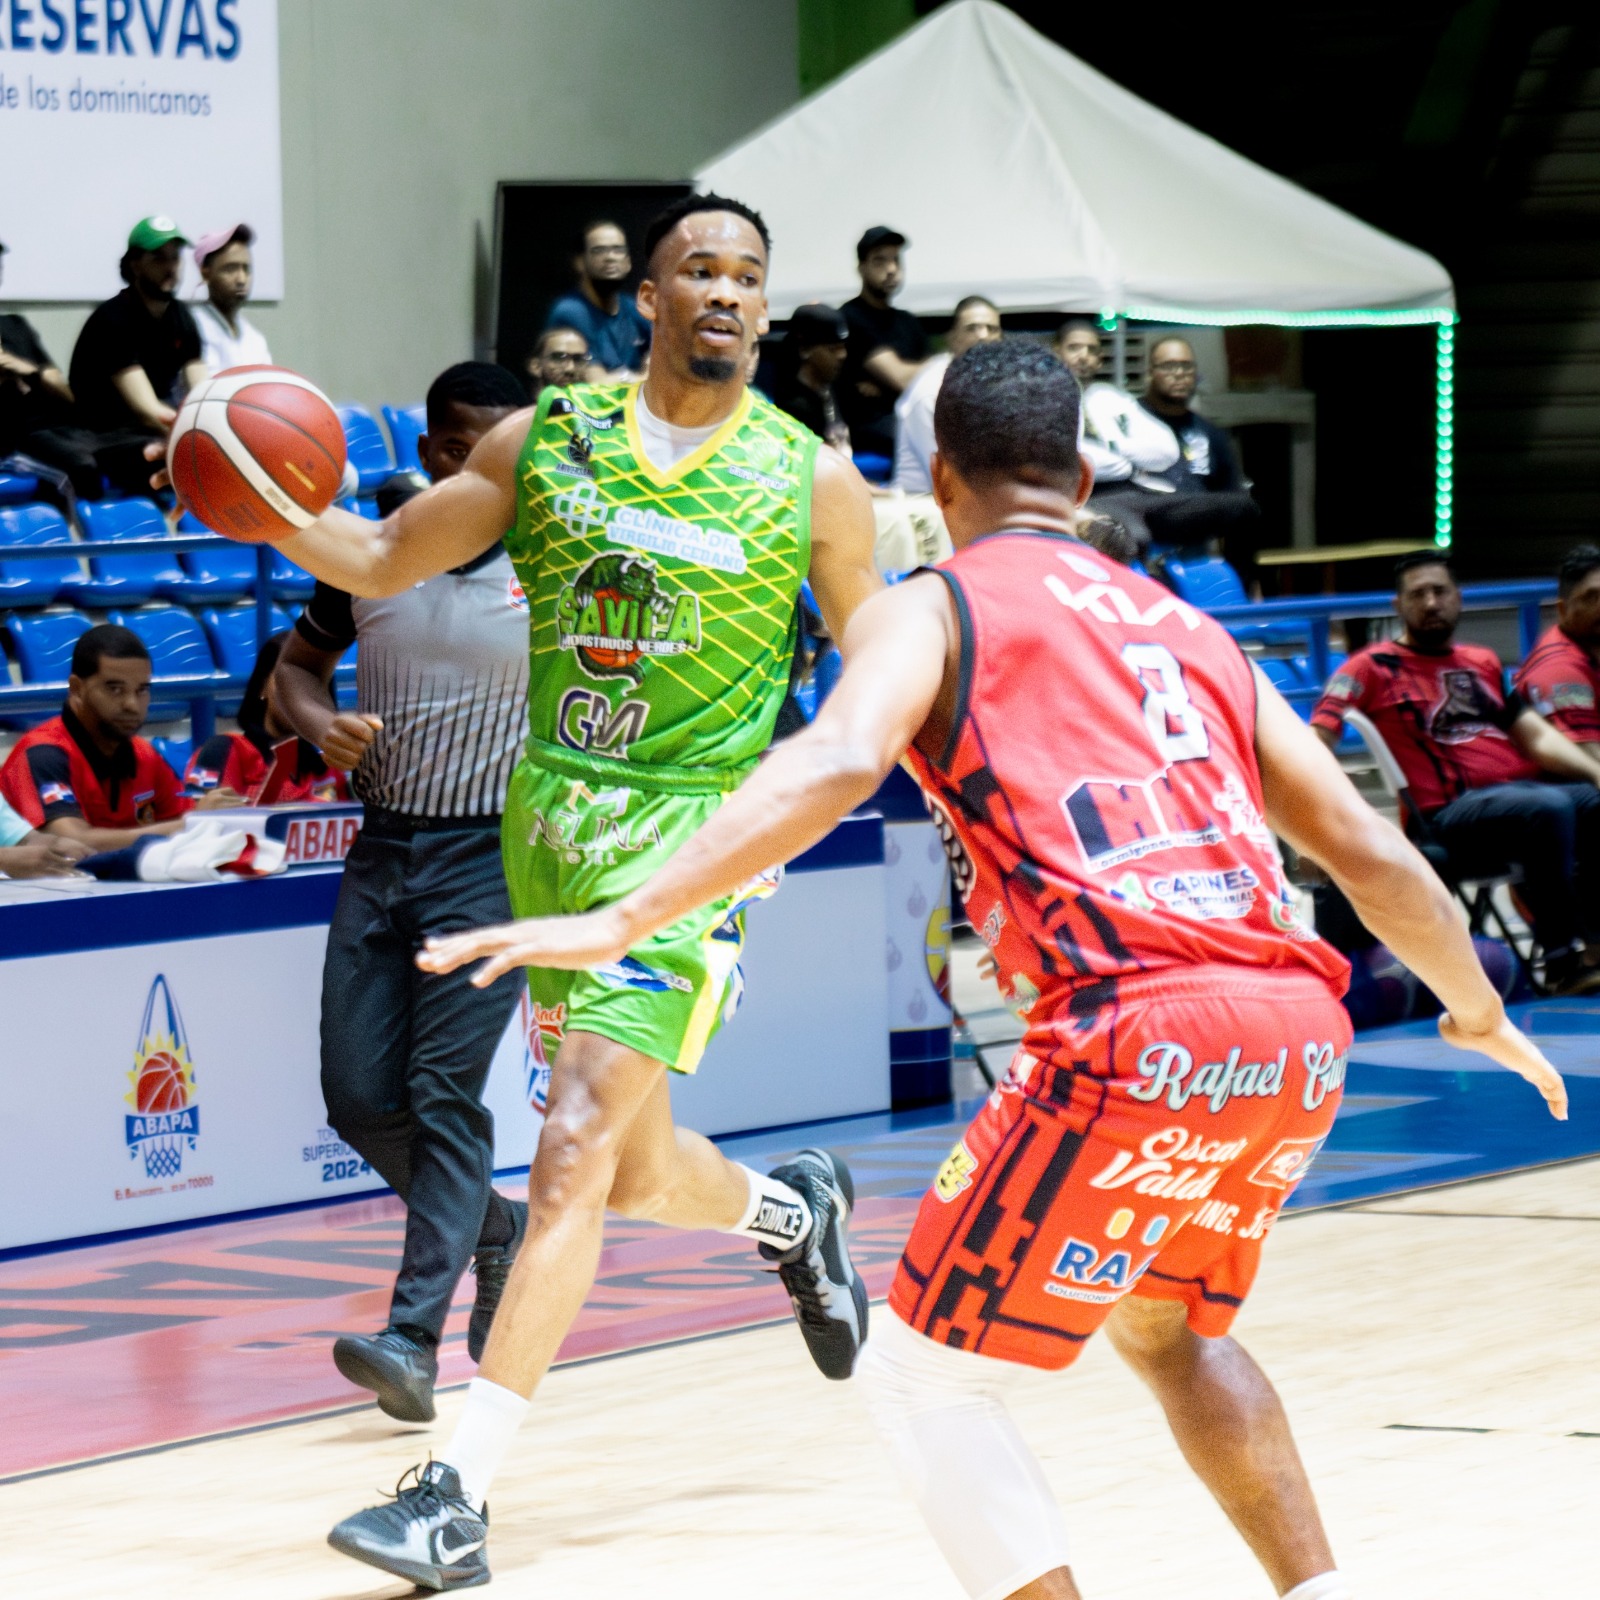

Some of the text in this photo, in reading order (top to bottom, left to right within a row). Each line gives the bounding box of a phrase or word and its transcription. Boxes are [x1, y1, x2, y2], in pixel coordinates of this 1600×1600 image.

[0, 0, 242, 62] ESERVAS
[28, 74, 60, 111] los
[69, 77, 212, 116] dominicanos
[558, 688, 649, 755] GM
[1121, 643, 1210, 762] 8
[1126, 1041, 1288, 1113] Rafael
[133, 1111, 193, 1137] ABAPA
[1140, 1126, 1249, 1163] Oscar
[322, 1159, 372, 1183] 2024
[751, 1201, 801, 1236] STANCE
